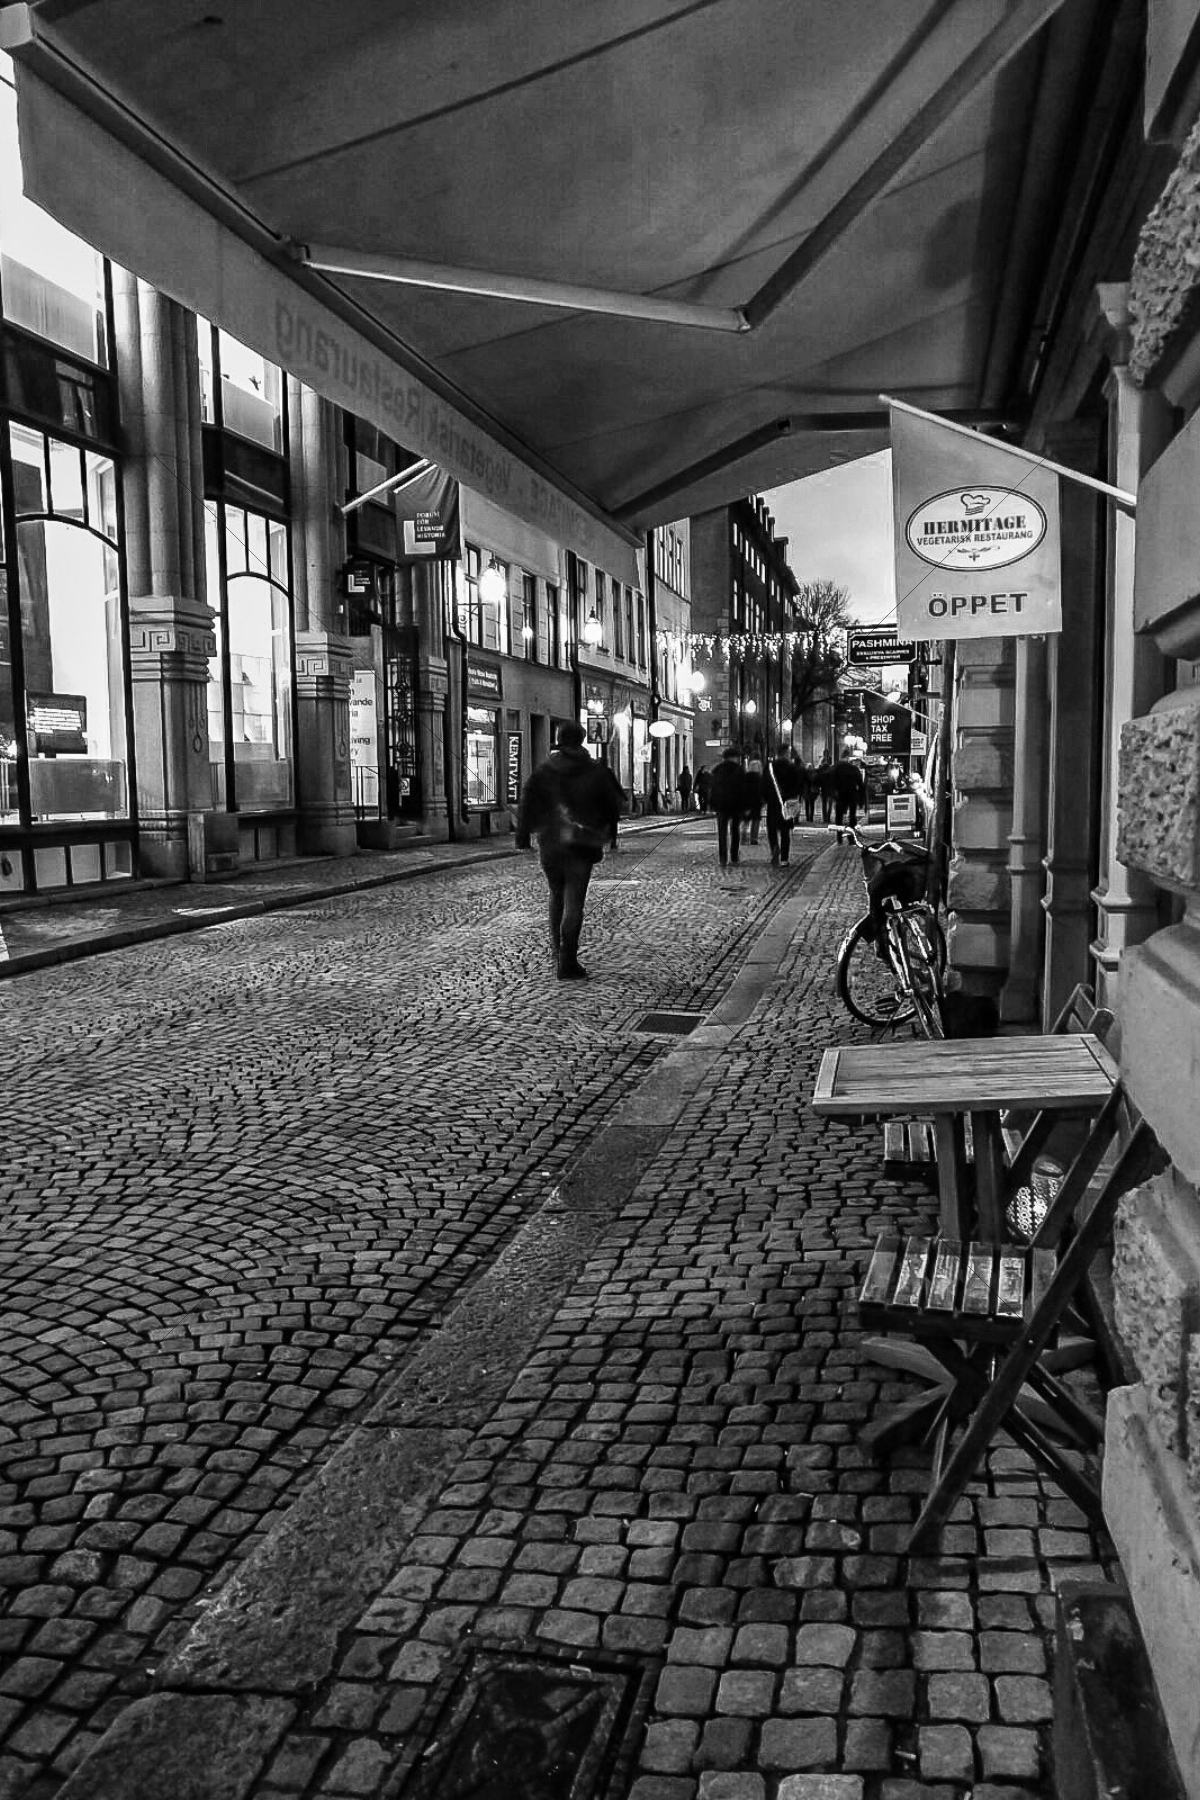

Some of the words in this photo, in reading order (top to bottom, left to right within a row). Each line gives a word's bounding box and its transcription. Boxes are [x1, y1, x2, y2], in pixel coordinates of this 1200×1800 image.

[923, 515, 1026, 535] HERMITAGE
[916, 533, 972, 546] VEGETARISK
[974, 530, 1033, 543] RESTAURANG
[928, 592, 1028, 618] ÖPPET
[852, 638, 913, 648] PASHMINA
[871, 714, 895, 724] SHOP
[871, 725, 888, 733] TAX
[871, 733, 893, 742] FREE
